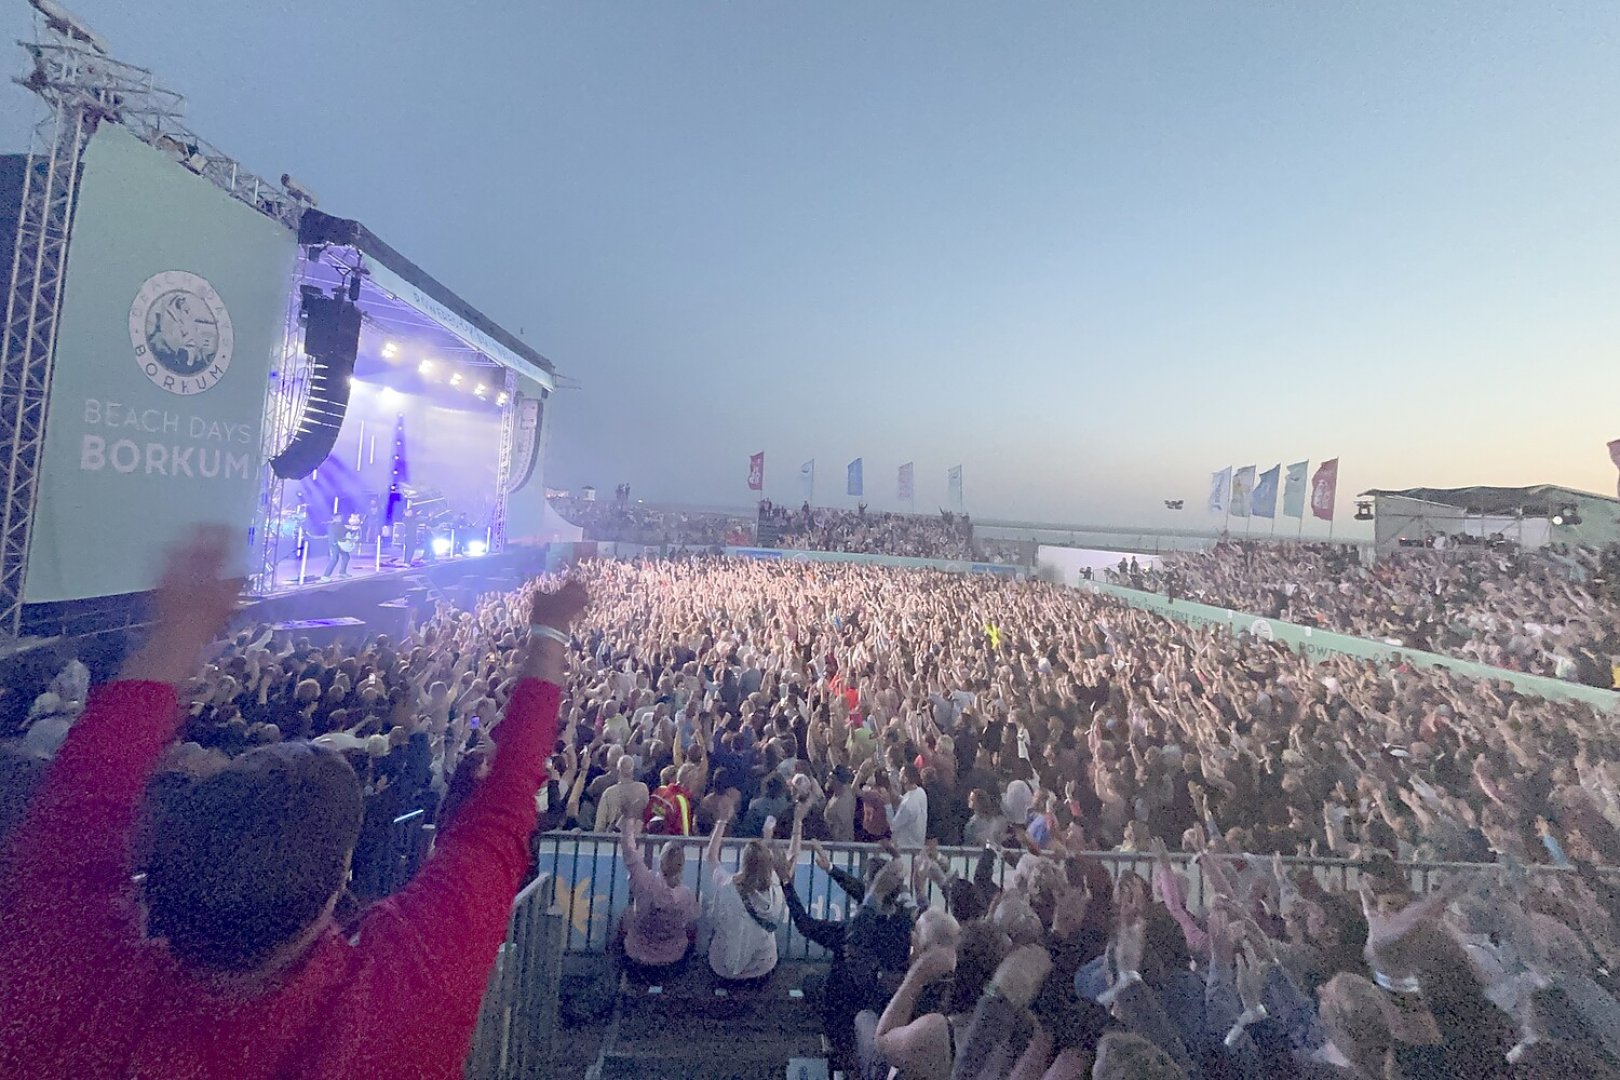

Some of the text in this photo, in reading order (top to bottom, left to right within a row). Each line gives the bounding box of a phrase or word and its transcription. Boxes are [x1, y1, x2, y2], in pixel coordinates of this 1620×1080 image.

[135, 344, 224, 393] BORKUM
[84, 399, 252, 444] BEACH DAYS
[80, 433, 249, 480] BORKUM
